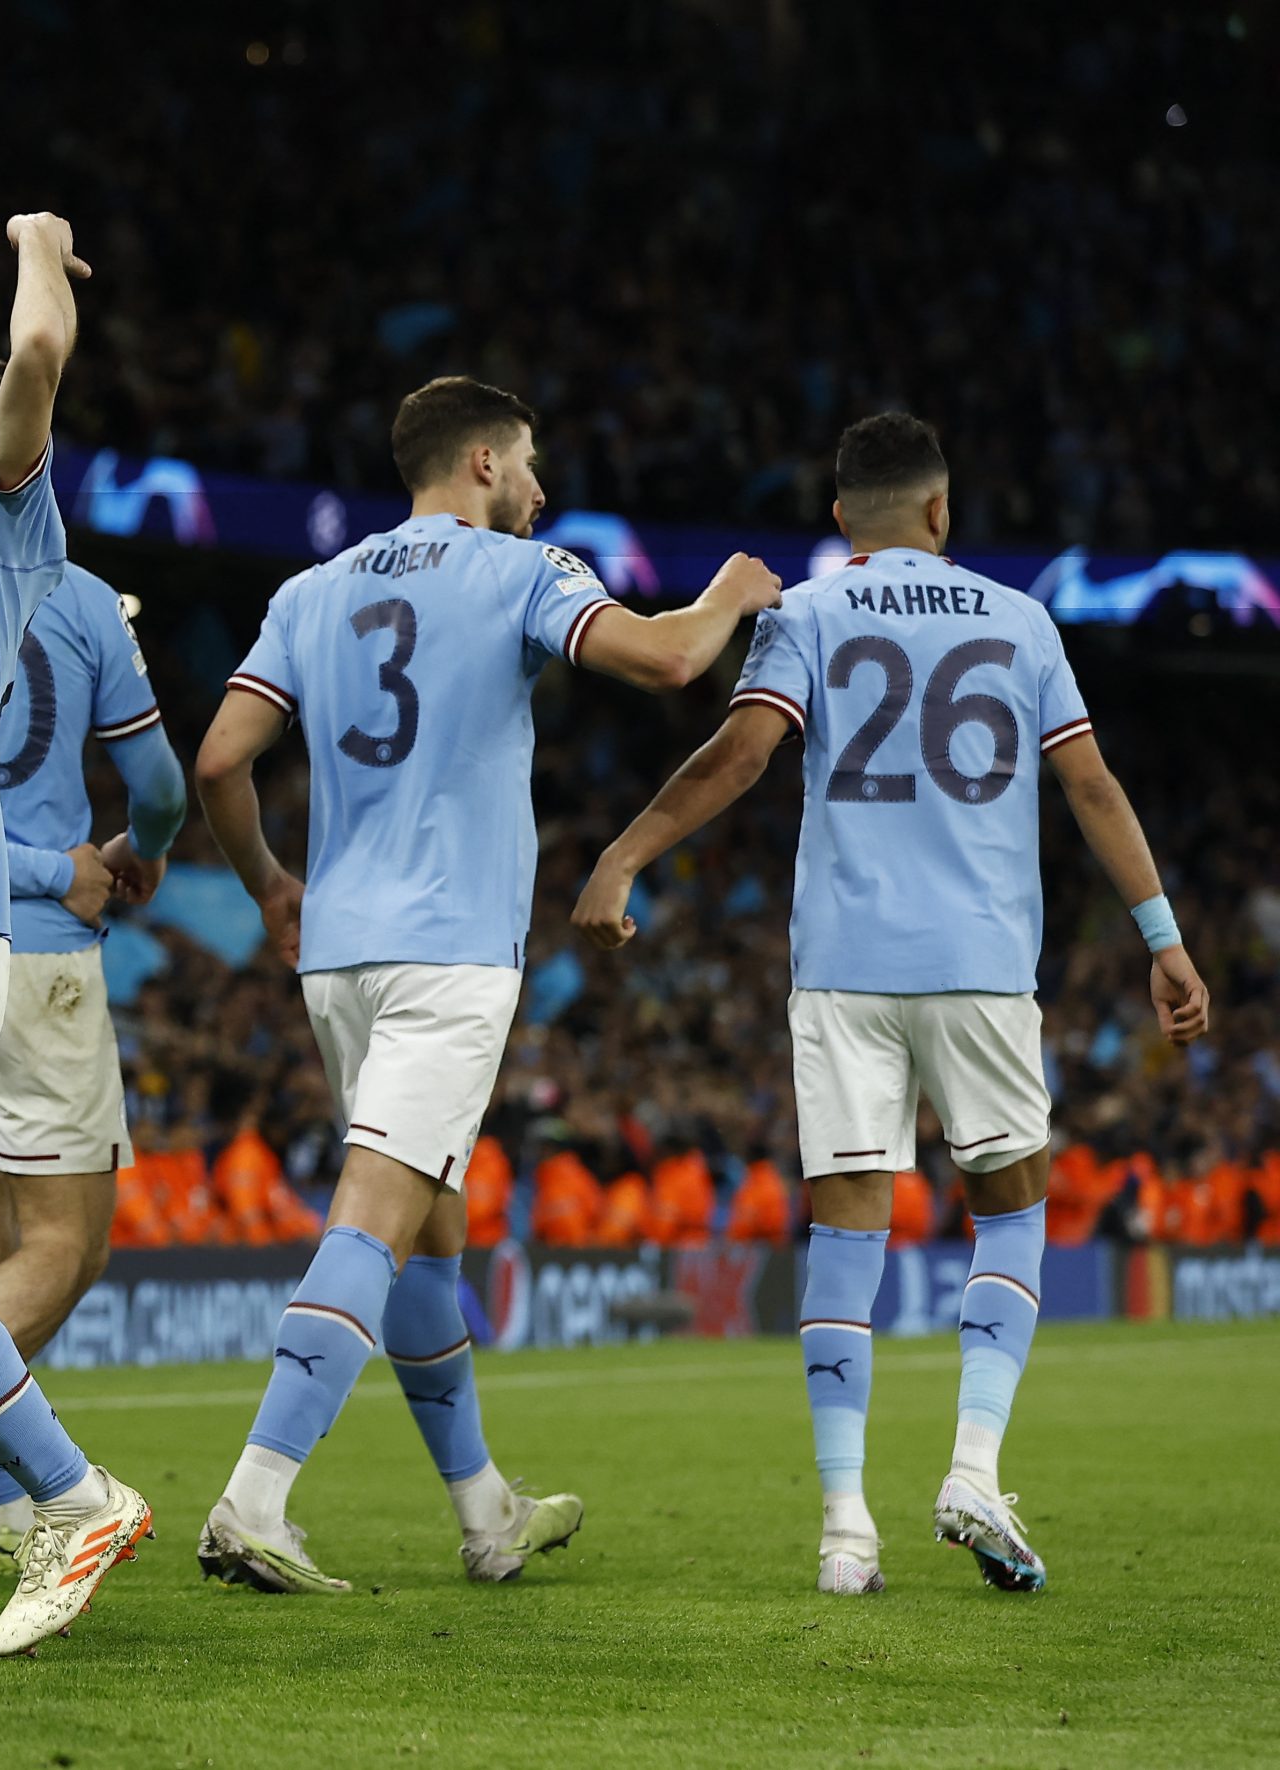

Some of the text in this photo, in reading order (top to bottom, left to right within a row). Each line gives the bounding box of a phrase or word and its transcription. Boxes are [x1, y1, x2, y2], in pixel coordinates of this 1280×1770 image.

[349, 540, 450, 579] RÚBEN
[845, 585, 990, 616] MAHREZ
[337, 598, 420, 768] 3
[825, 635, 1019, 806] 26
